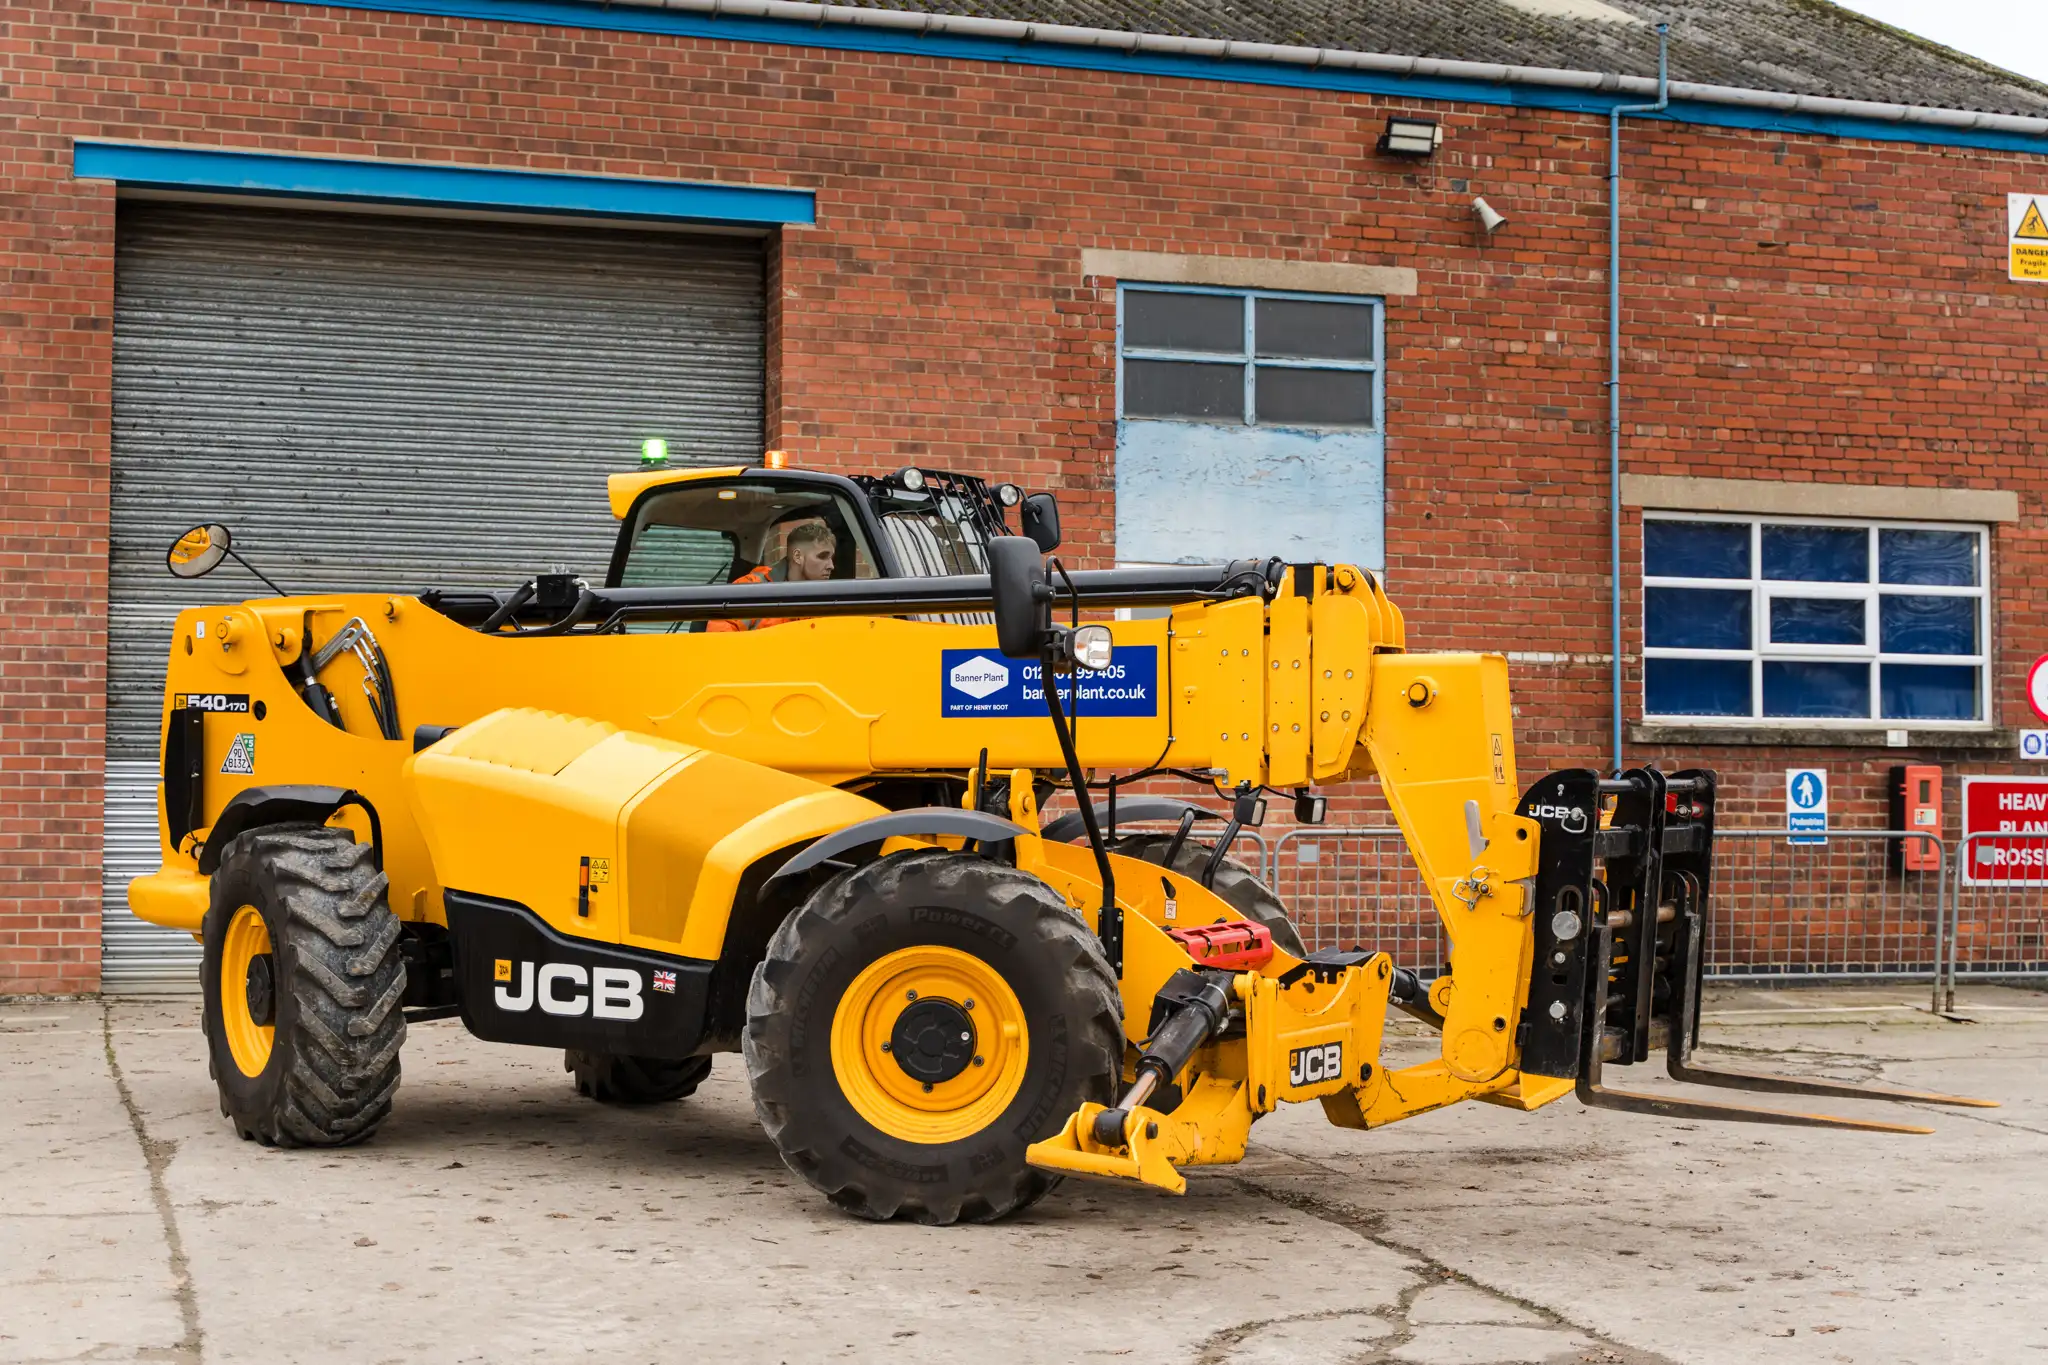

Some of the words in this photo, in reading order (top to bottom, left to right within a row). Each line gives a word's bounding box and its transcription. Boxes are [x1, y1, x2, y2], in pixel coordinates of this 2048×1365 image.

[2020, 258, 2047, 267] Fragile
[955, 673, 982, 682] Banner
[983, 673, 1004, 682] Plant
[1023, 666, 1064, 680] 012
[1067, 666, 1094, 680] 99
[1023, 683, 1146, 702] banerlant.co.uk
[1999, 792, 2048, 811] HEAV
[1529, 805, 1569, 819] JCB
[1982, 847, 2048, 867] ROSS
[494, 960, 645, 1022] JCB
[1290, 1045, 1341, 1085] JCB
